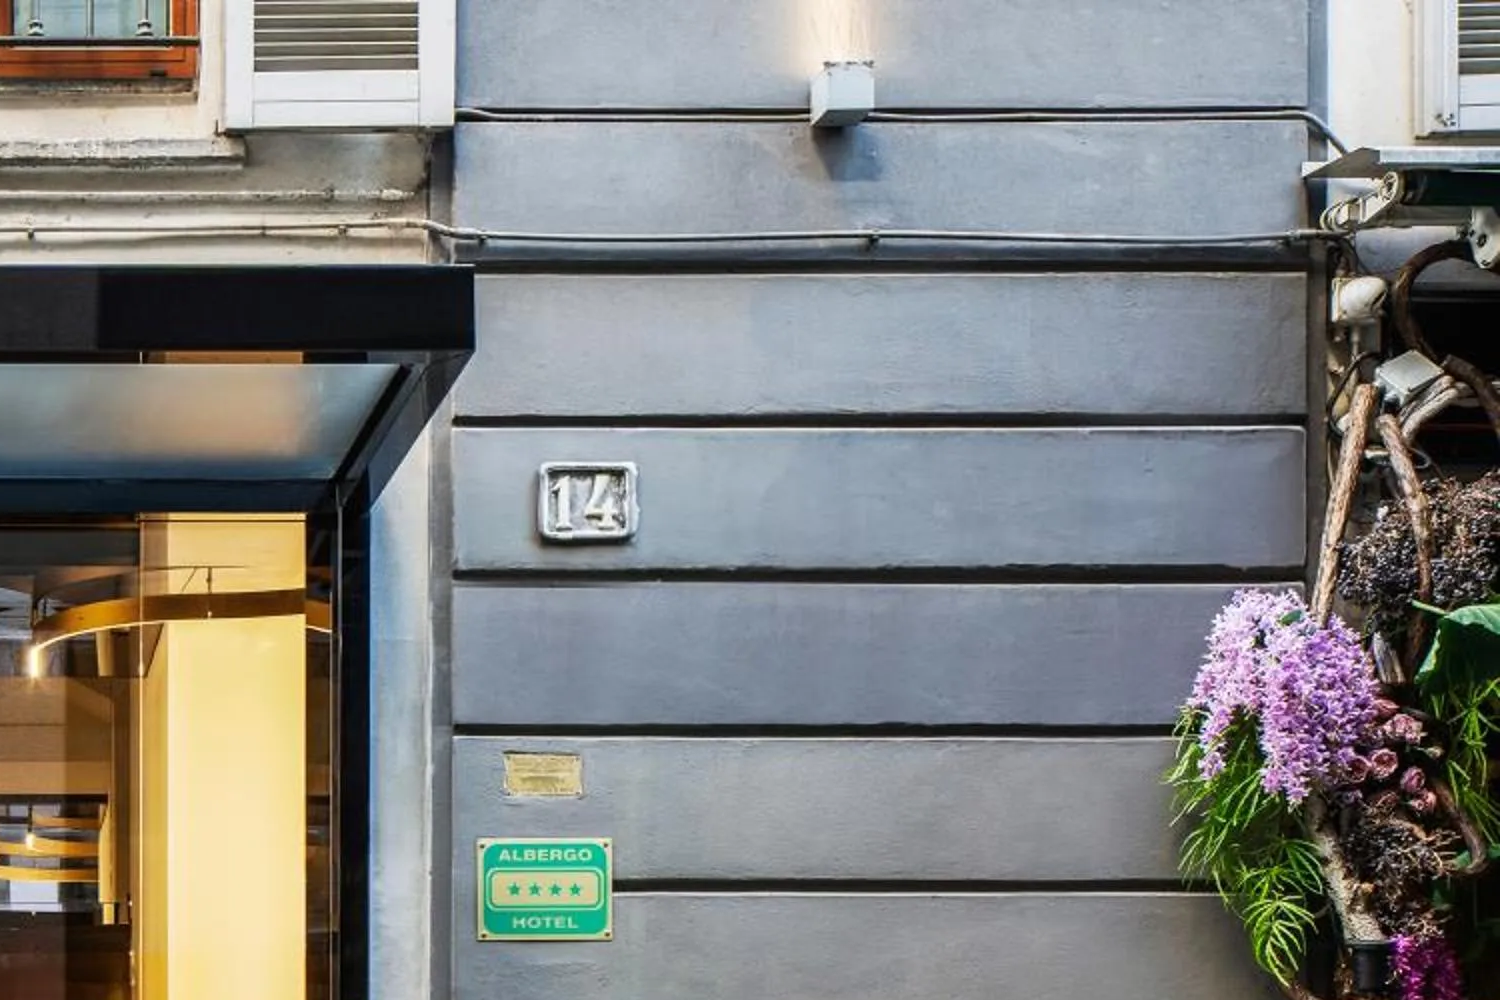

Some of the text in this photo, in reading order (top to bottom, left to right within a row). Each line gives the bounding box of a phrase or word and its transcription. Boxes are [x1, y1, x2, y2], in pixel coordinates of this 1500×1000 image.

[551, 474, 619, 529] 14
[499, 849, 592, 861] ALBERGO
[512, 917, 579, 929] HOTEL
